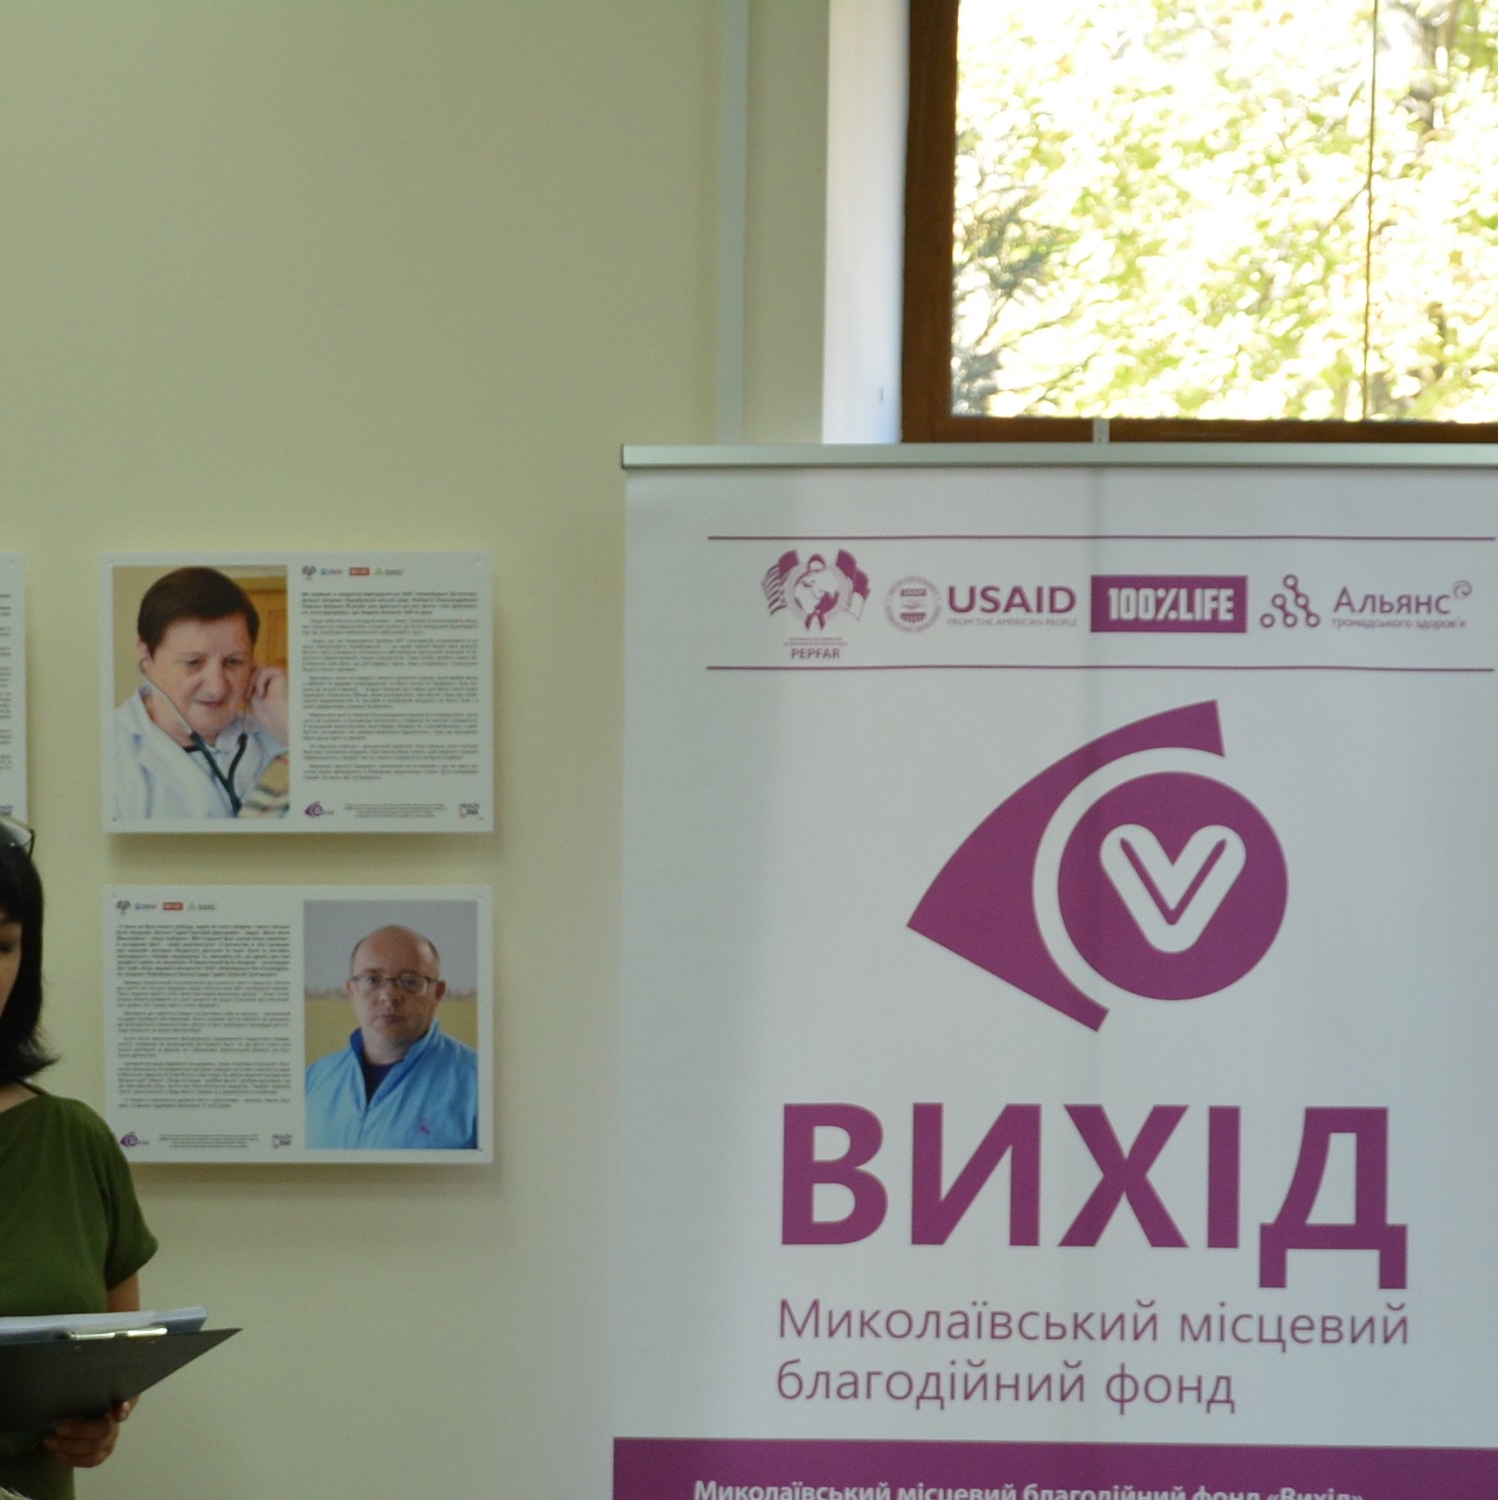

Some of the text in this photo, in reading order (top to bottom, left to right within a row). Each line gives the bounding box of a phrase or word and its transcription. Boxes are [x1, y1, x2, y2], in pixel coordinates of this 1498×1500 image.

[949, 586, 1076, 613] USAID
[1109, 588, 1233, 621] 100%LIFE
[1333, 586, 1452, 614] Альянс
[948, 617, 1078, 627] FROM THE AMERICAN PEOPLE
[790, 647, 842, 660] PEPFAR
[782, 1103, 1407, 1289] ВИХІД
[780, 1299, 1408, 1353] Миколаївський місцевий
[777, 1359, 1235, 1415] благодійний фонд
